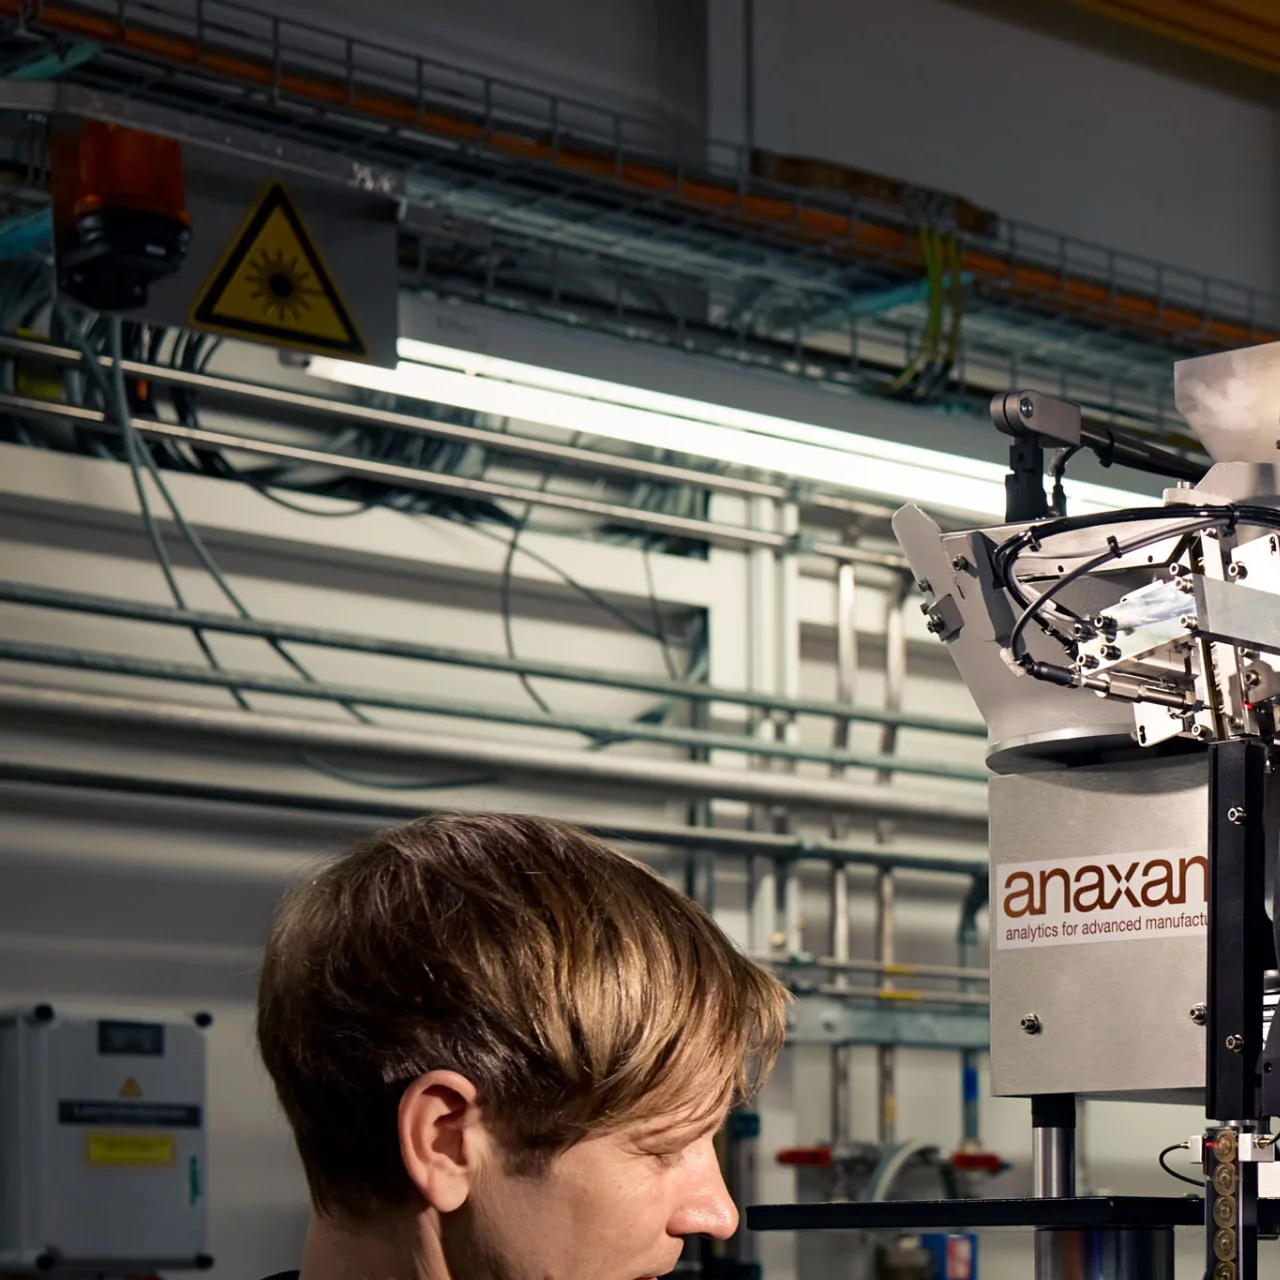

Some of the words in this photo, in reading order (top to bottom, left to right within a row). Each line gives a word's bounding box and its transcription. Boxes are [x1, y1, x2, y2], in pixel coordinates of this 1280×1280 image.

[1006, 920, 1058, 941] analytics
[1062, 919, 1078, 937] for
[1082, 914, 1141, 935] advanced
